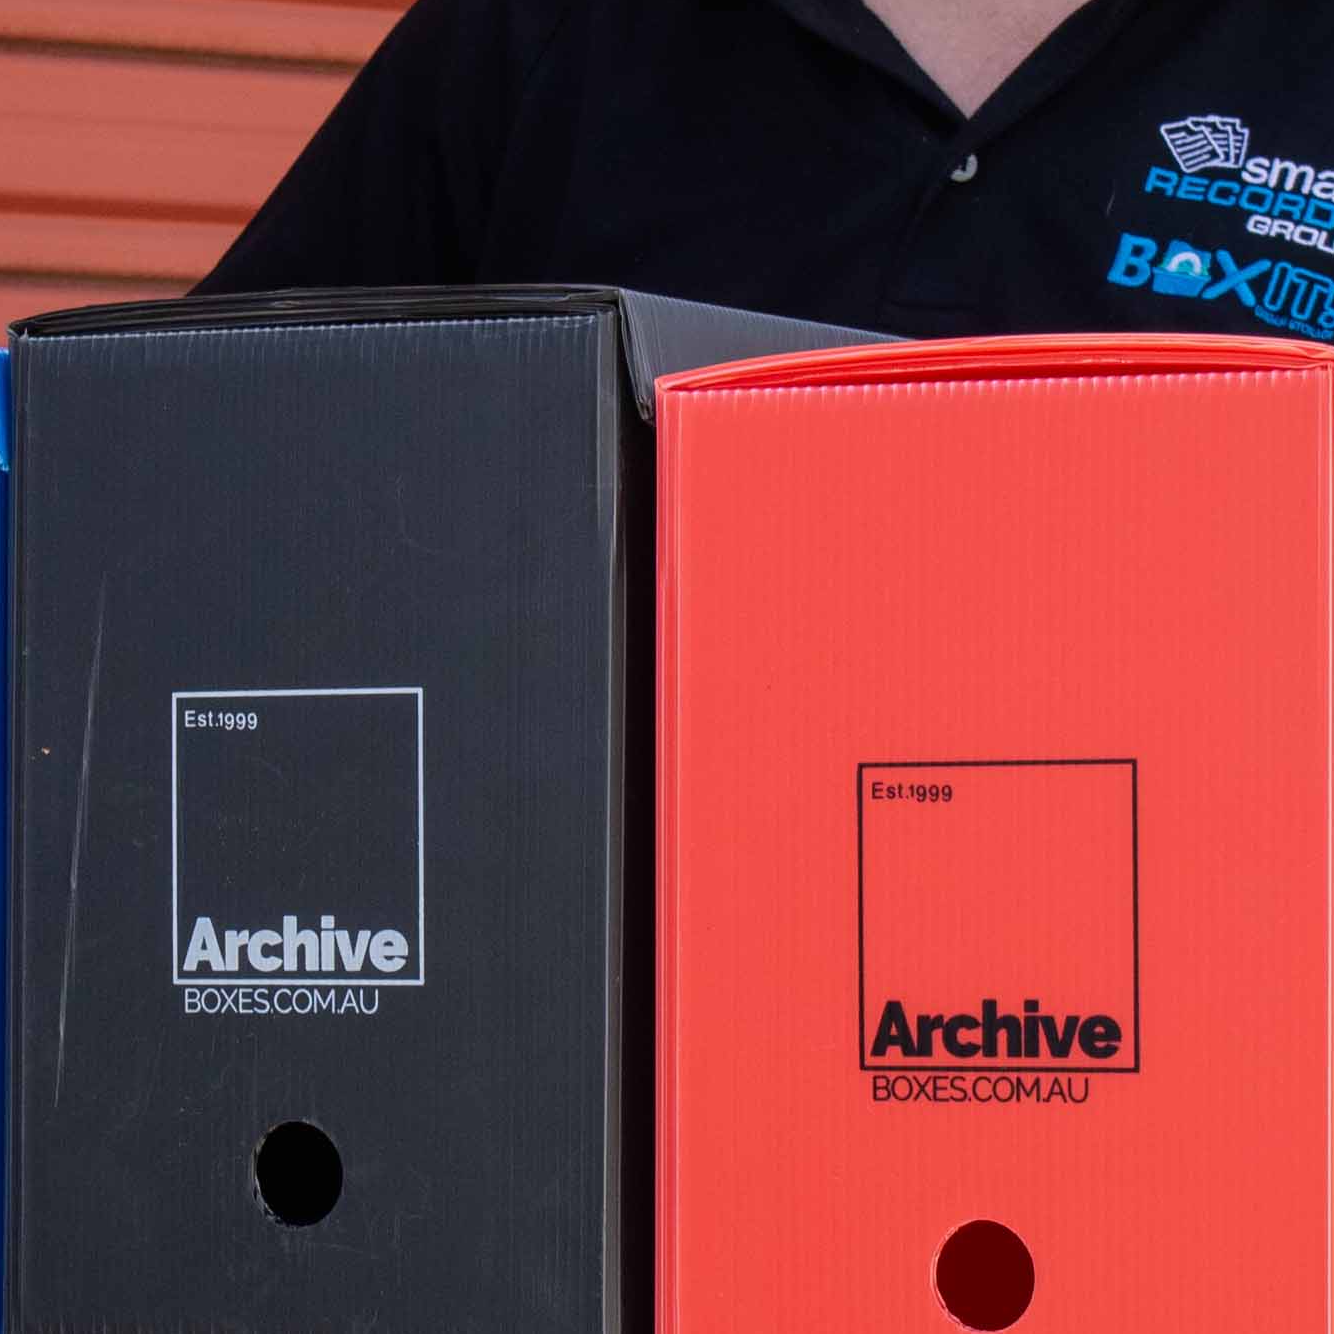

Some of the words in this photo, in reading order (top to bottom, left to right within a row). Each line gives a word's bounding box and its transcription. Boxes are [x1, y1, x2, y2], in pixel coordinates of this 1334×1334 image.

[183, 915, 409, 973] Archive
[184, 988, 379, 1015] BOXES.COM.AU
[870, 999, 1123, 1060] Archive
[872, 1075, 1089, 1104] BOXES.COM.AU
